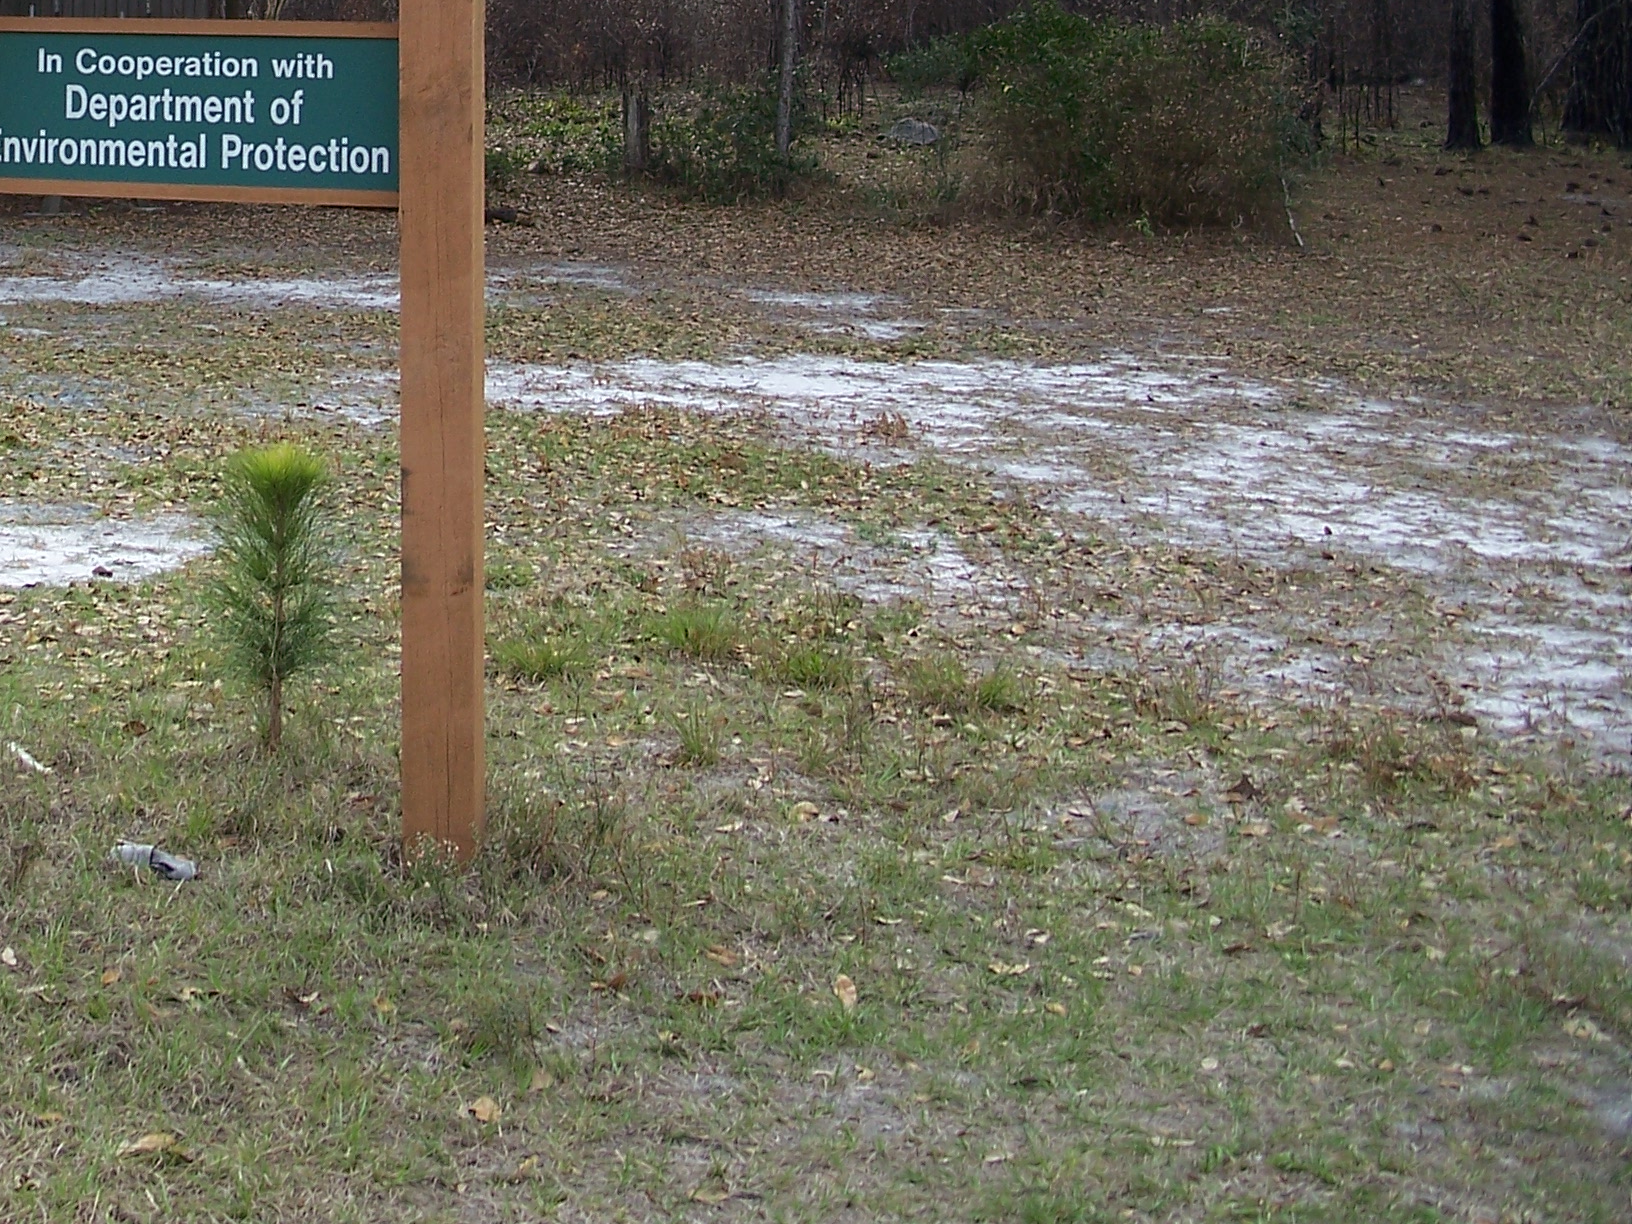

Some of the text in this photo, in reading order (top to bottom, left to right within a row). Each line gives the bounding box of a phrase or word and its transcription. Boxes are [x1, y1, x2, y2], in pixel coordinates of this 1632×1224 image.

[37, 47, 334, 80] In Cooperation with
[65, 83, 305, 127] Department of
[221, 134, 390, 174] Protection
